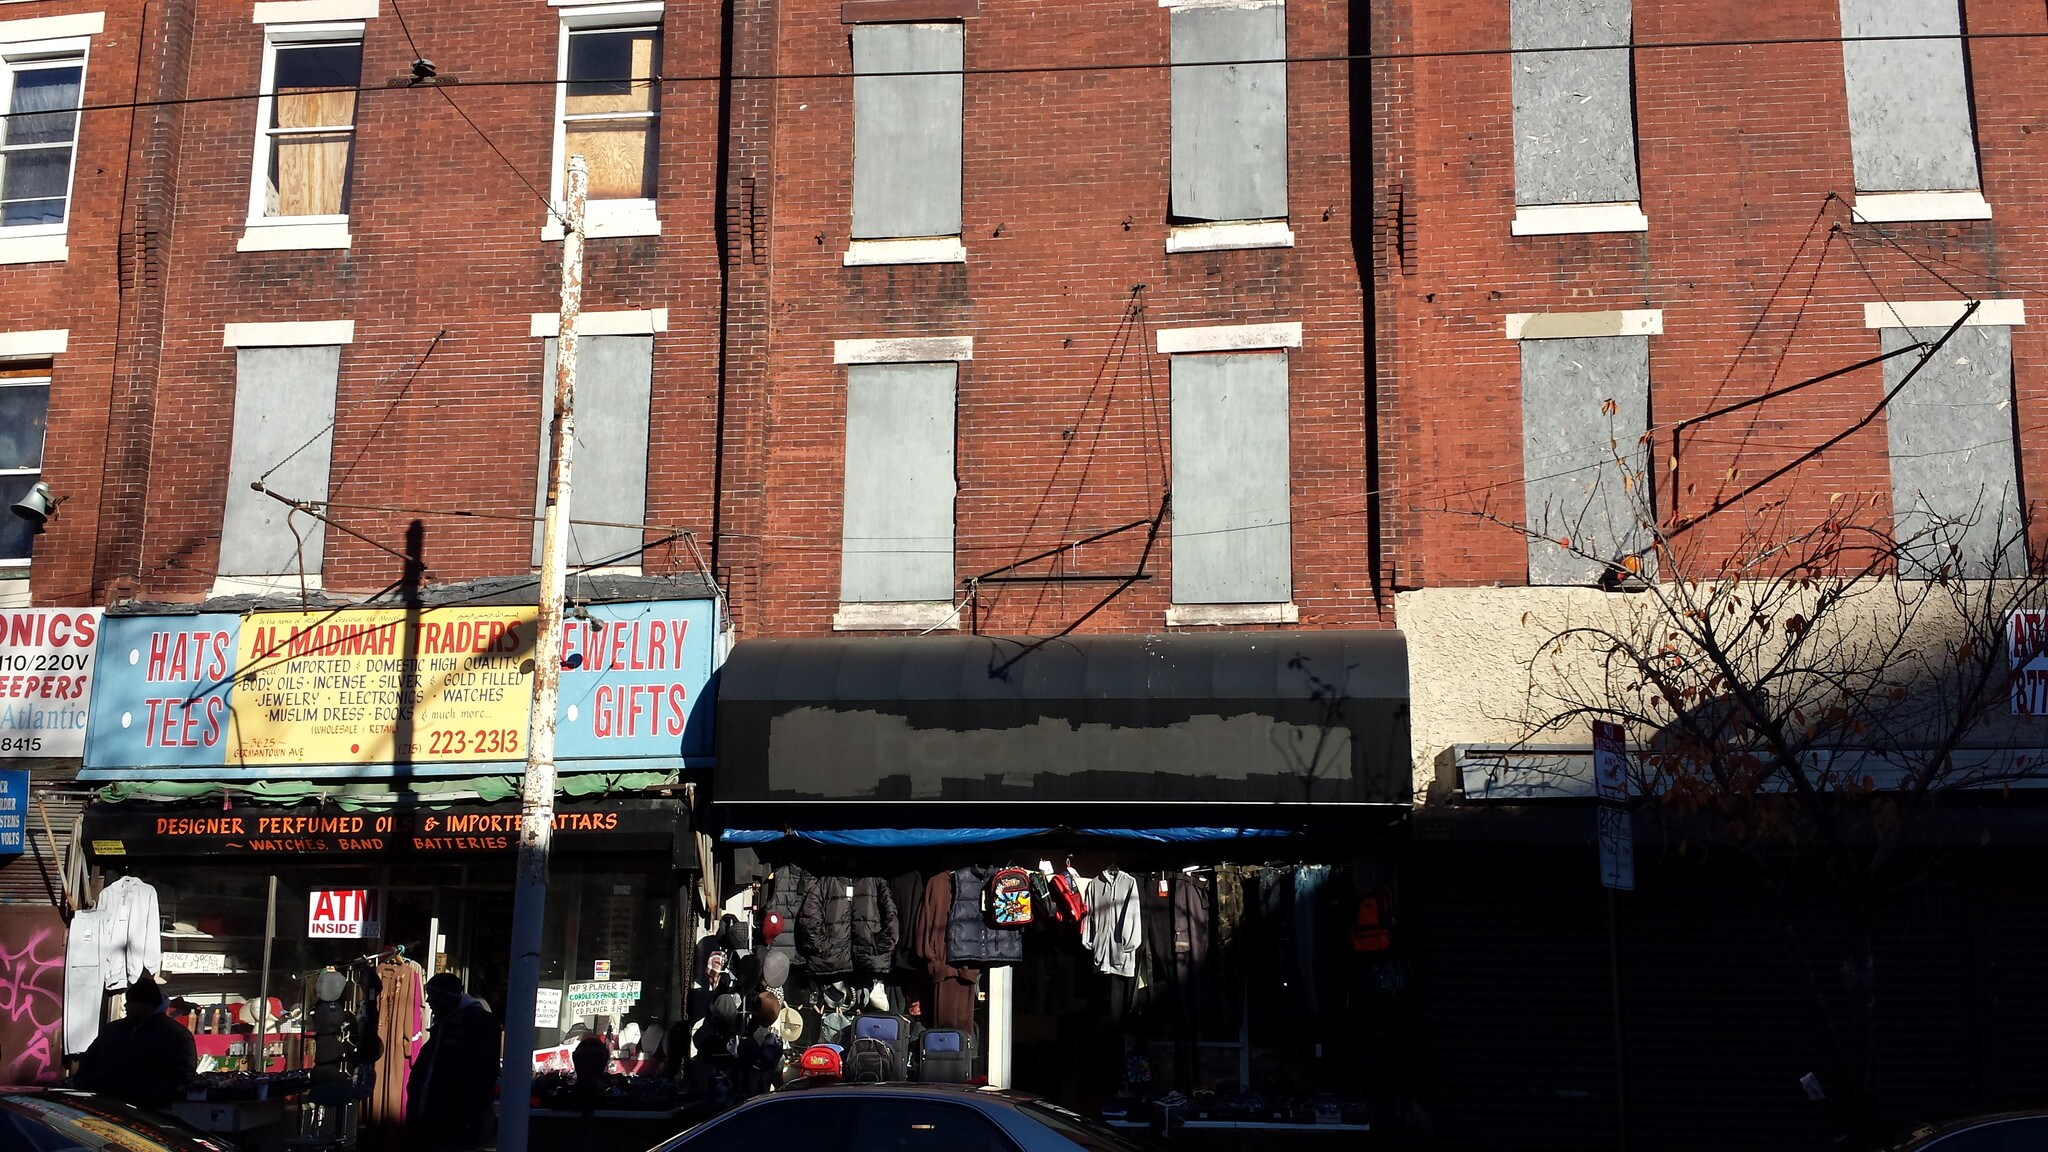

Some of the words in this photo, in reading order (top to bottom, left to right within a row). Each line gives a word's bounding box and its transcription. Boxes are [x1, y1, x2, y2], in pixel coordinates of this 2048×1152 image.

[250, 624, 396, 659] AL-MADINAH
[411, 620, 521, 655] TRADERS
[560, 619, 689, 672] EWELRY
[146, 630, 231, 683] HATS
[286, 659, 351, 674] IMPORTED
[366, 658, 425, 673] DOMESTIC
[430, 657, 457, 671] HIGH
[463, 656, 521, 671] QUALITY
[242, 677, 273, 692] BODY
[277, 676, 304, 690] OILS
[313, 674, 367, 689] INCENSE
[378, 674, 423, 689] SILVER
[443, 672, 476, 687] GOLD
[481, 671, 524, 686] FILLED
[257, 691, 320, 707] JEWELRY
[339, 690, 424, 706] ELECTRONICS
[443, 687, 504, 703] WATCHES
[0, 702, 86, 730] Atlantic
[268, 707, 318, 722] MUSLIM
[323, 706, 365, 722] DRESS
[374, 706, 414, 721] BOOKS
[431, 707, 456, 720] much
[593, 682, 687, 739] GIFTS
[145, 696, 224, 748] TEES
[233, 748, 286, 758] GERMANTOWN
[288, 747, 304, 757] AVE
[429, 729, 518, 755] 223-2313
[156, 817, 245, 835] DESIGNER
[258, 816, 364, 835] PERFUMED
[424, 816, 440, 832] &
[446, 814, 522, 833] IMPORTE
[338, 837, 384, 850] BAND
[413, 836, 507, 850] BATTERIES
[313, 889, 379, 922] ATM
[312, 923, 357, 934] INSIDE
[589, 982, 617, 991] PLAYER
[573, 1000, 585, 1008] DVD
[586, 1006, 608, 1014] PLAYER
